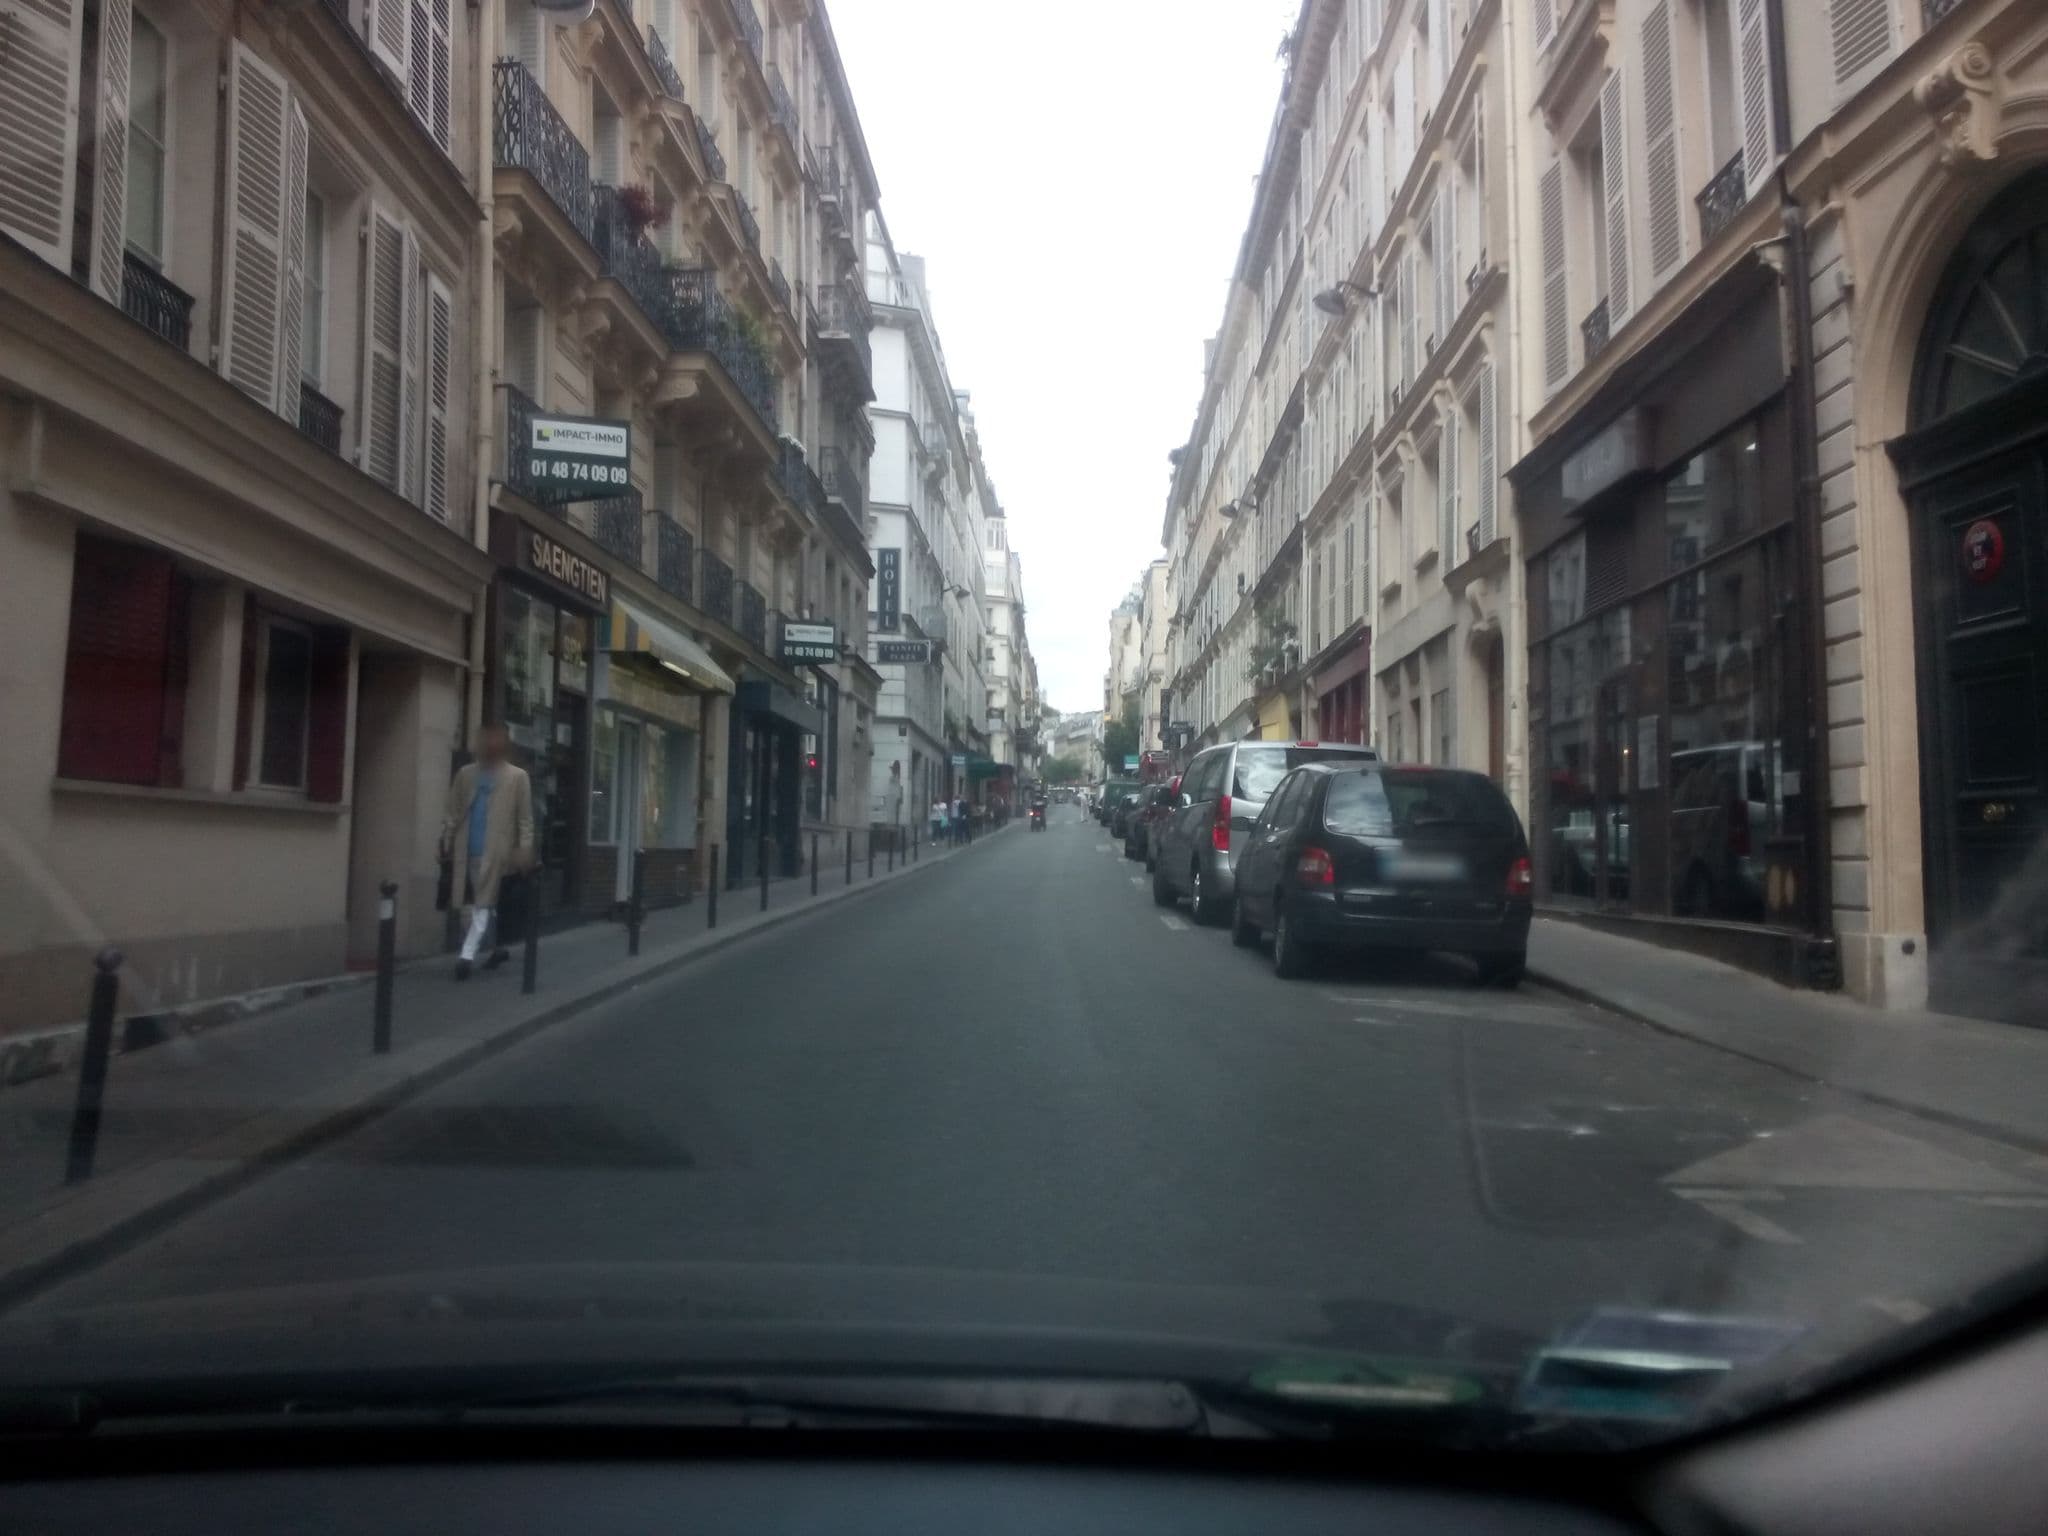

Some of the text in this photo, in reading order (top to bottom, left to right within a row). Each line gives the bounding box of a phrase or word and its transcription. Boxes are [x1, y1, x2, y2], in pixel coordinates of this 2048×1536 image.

[553, 429, 623, 444] IMPACT-IMMO
[532, 459, 628, 484] 01 48 74 09 09
[532, 533, 607, 604] SAENGTIEN
[884, 553, 895, 628] HOTEL
